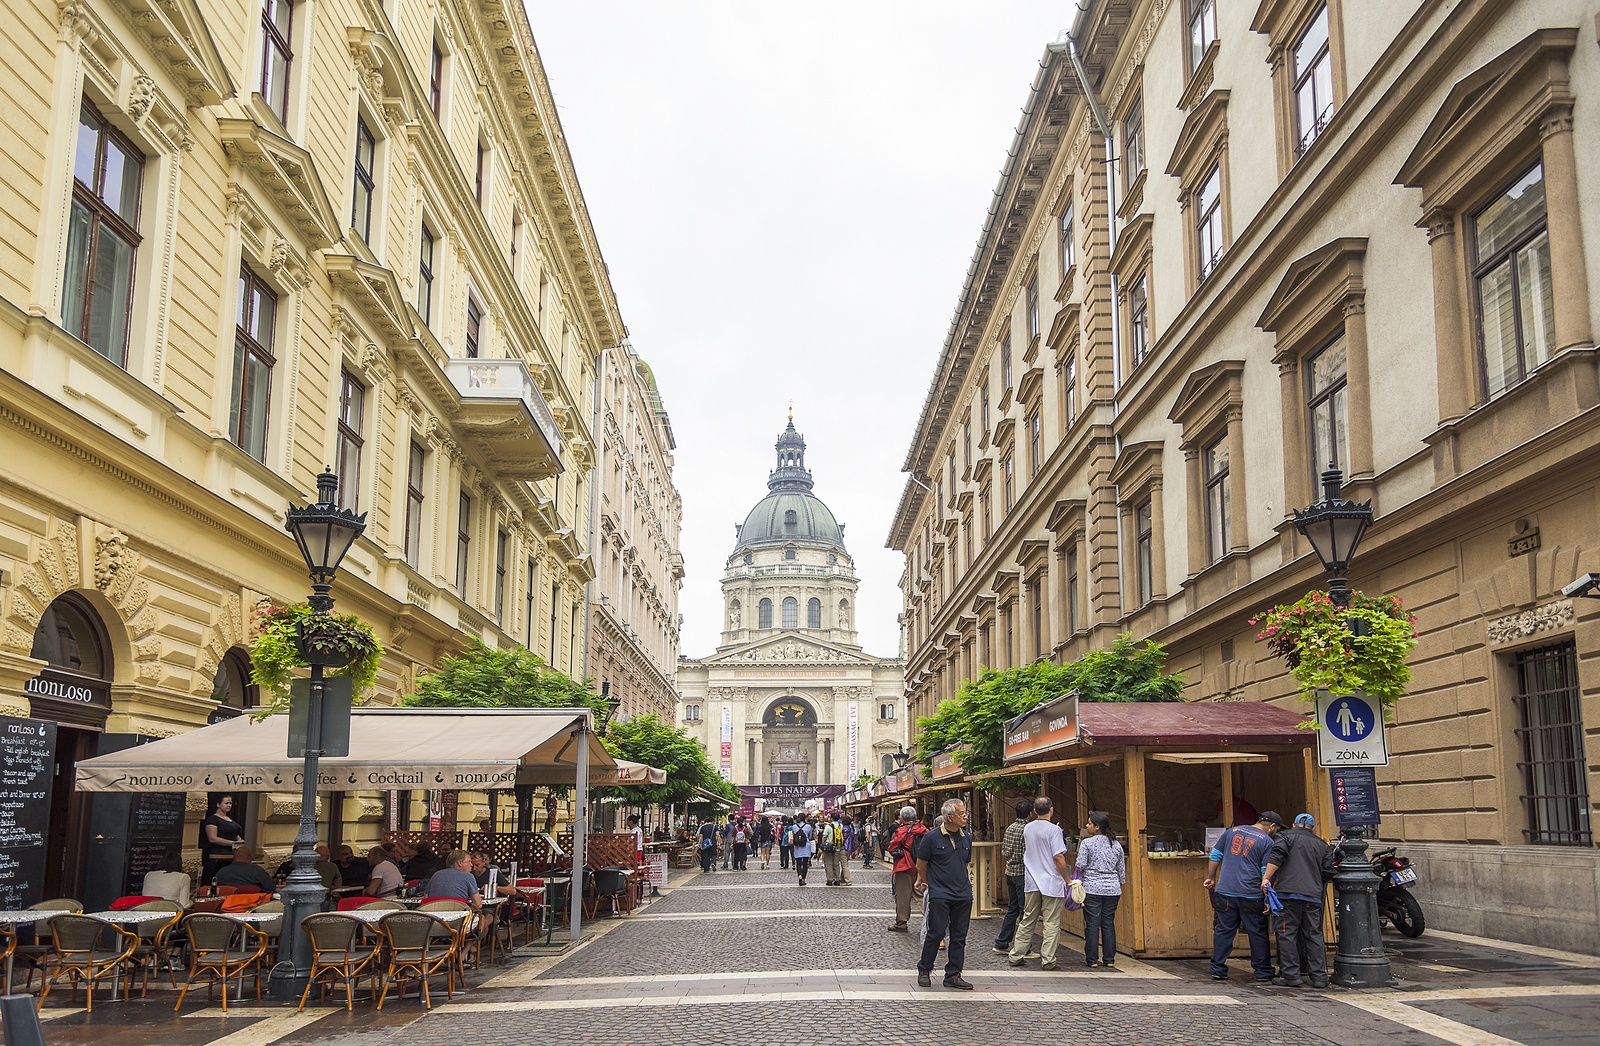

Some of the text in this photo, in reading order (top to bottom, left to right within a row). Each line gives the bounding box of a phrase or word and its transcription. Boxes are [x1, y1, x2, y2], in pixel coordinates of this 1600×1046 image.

[1048, 715, 1069, 732] GOVINDA
[226, 773, 263, 785] Wine
[293, 772, 337, 785] Cfee
[368, 771, 424, 784] Cocktail
